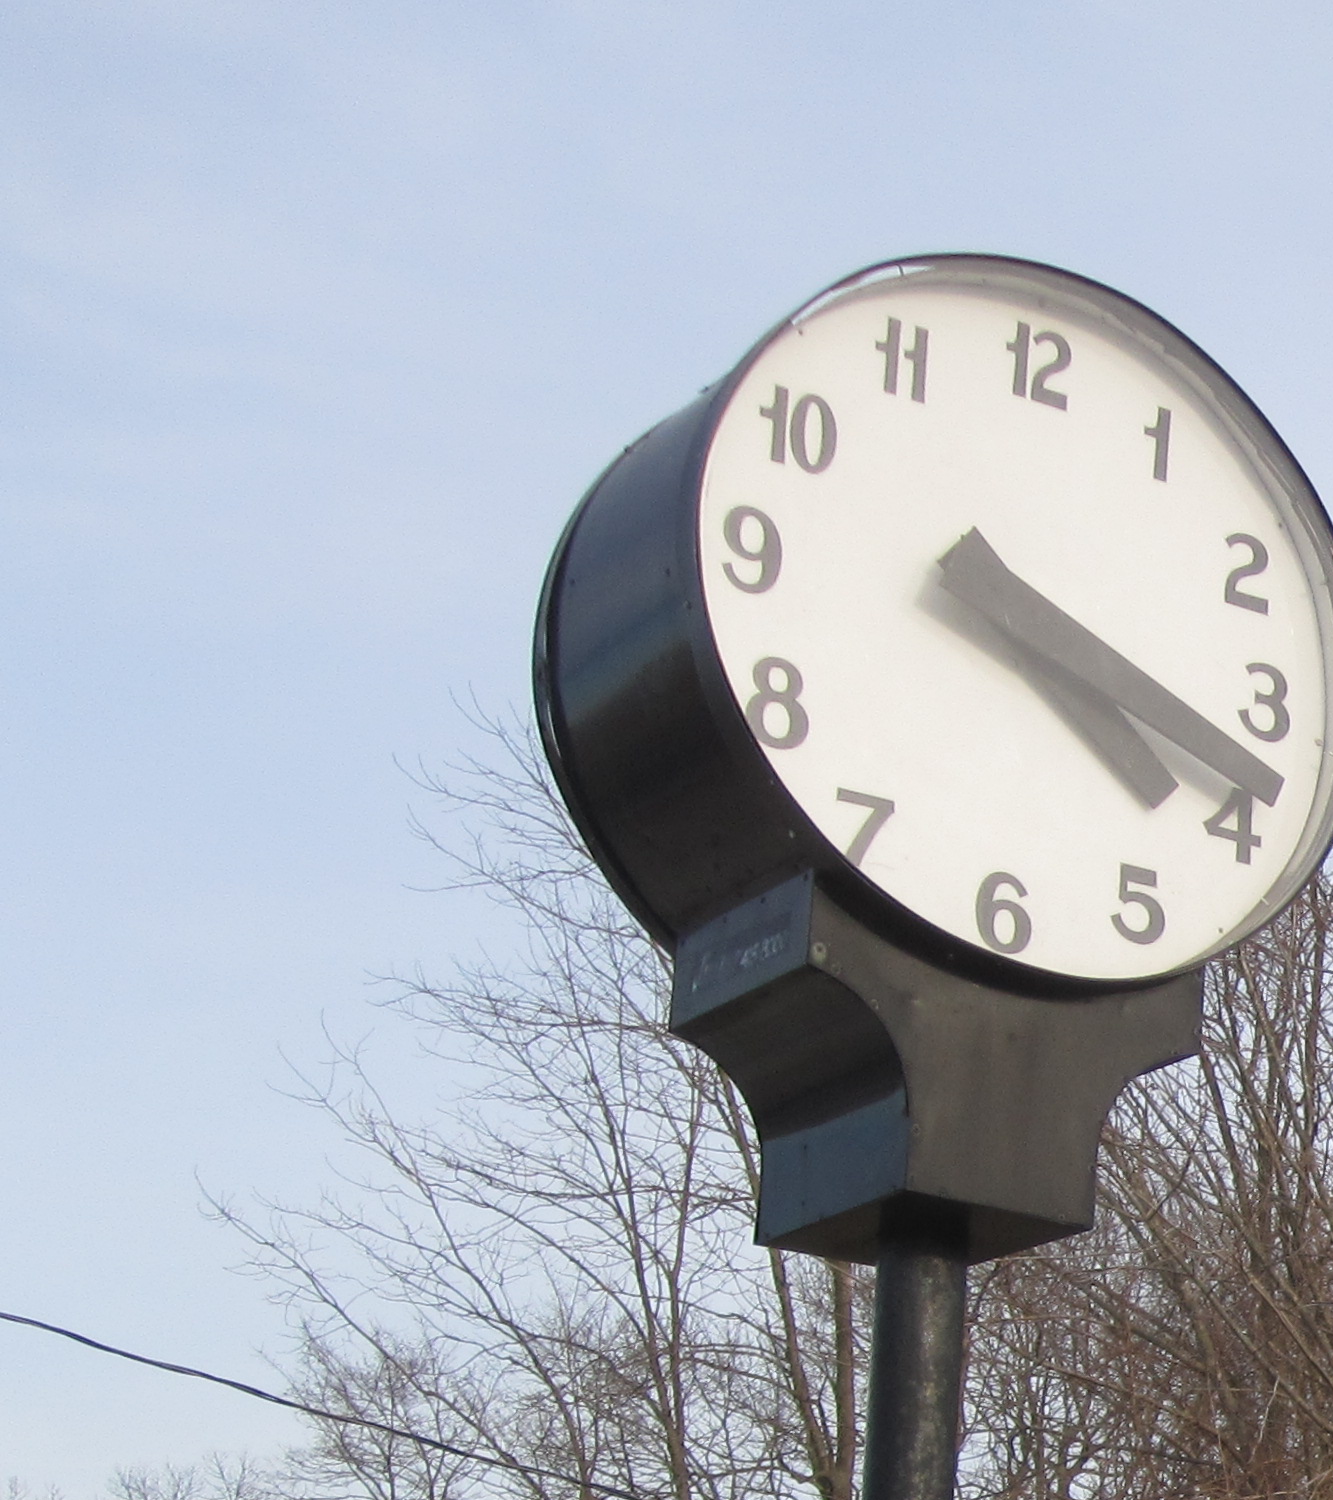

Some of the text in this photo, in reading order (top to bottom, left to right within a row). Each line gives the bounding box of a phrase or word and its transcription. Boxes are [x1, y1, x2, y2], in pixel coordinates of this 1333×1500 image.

[874, 316, 929, 403] 11
[1005, 320, 1072, 412] 12
[759, 384, 838, 475] 10
[1142, 406, 1171, 482] 1
[721, 505, 783, 594] 9
[1223, 532, 1270, 616] 2
[744, 655, 810, 750] 8
[1237, 662, 1291, 743] 3
[834, 787, 896, 868] 7
[1202, 786, 1263, 865] 4
[975, 871, 1033, 955] 6
[1109, 861, 1167, 945] 5
